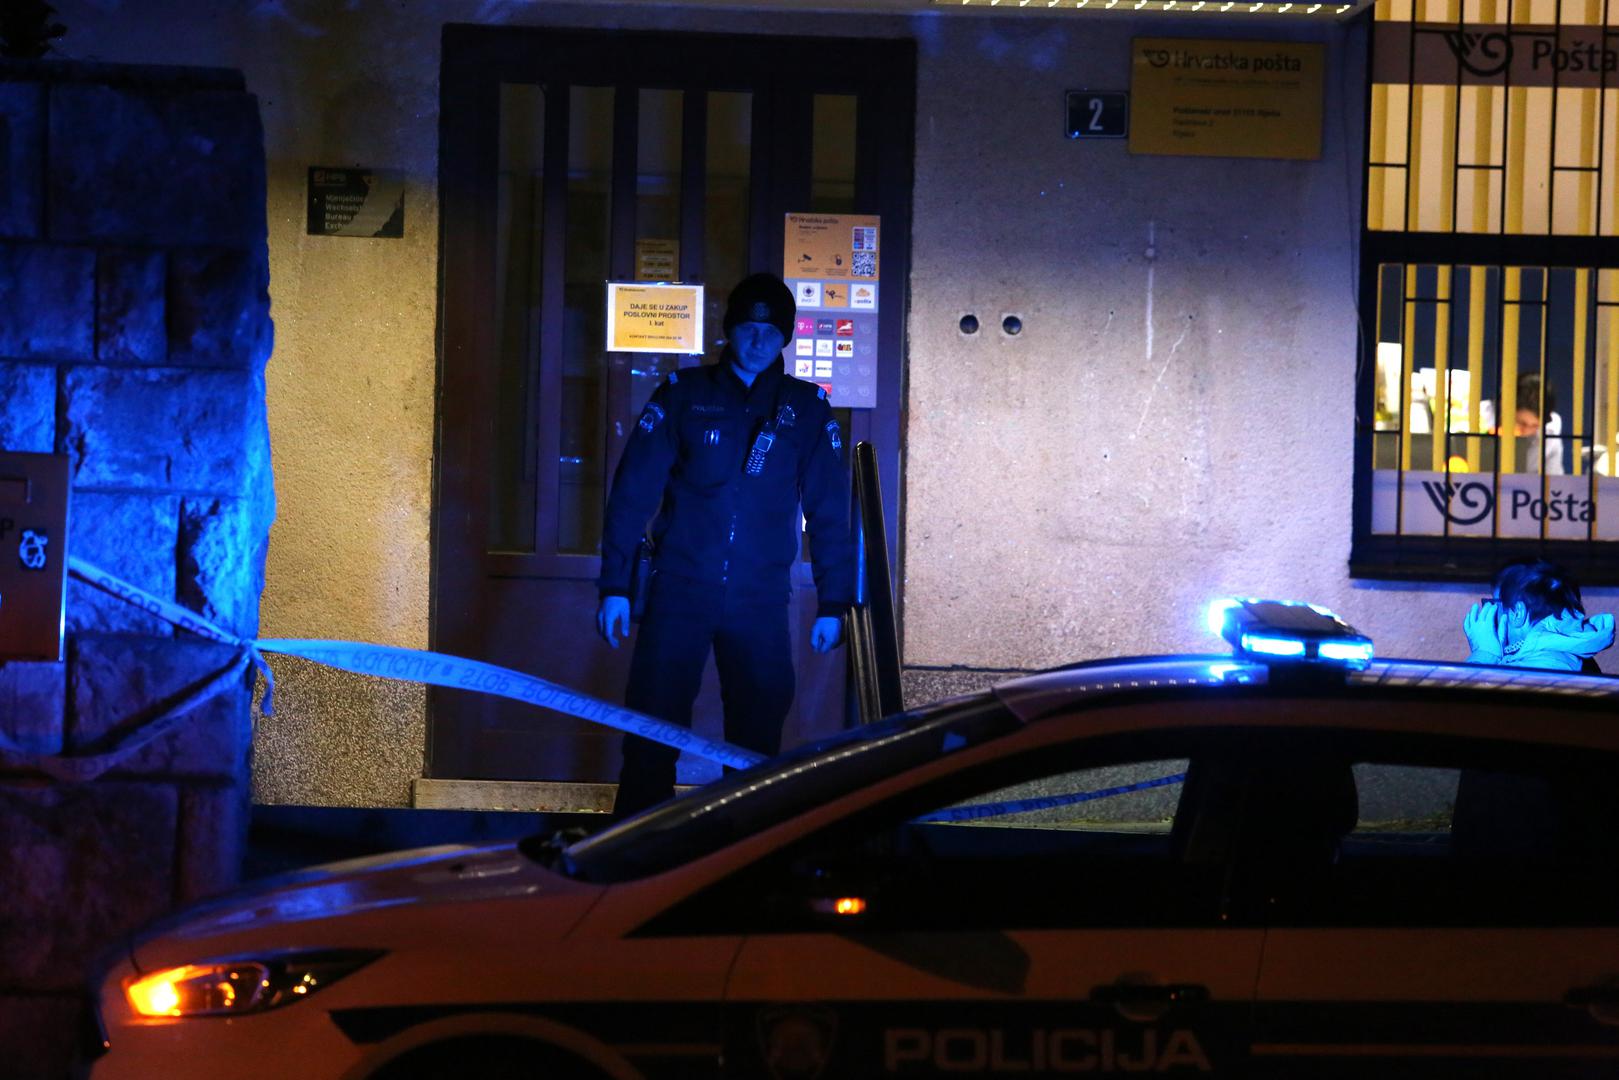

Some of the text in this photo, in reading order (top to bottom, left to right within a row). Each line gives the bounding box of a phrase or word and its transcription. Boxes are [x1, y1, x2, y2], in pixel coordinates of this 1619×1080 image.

[1174, 50, 1301, 72] Hrvatska pošta
[1532, 39, 1617, 72] Pošta
[1088, 98, 1104, 131] 2
[623, 311, 690, 320] POSLOVNI PROSTOR
[665, 304, 688, 312] ZAKUP
[1511, 488, 1597, 523] Pošta
[881, 1026, 1215, 1073] POLICIJA
